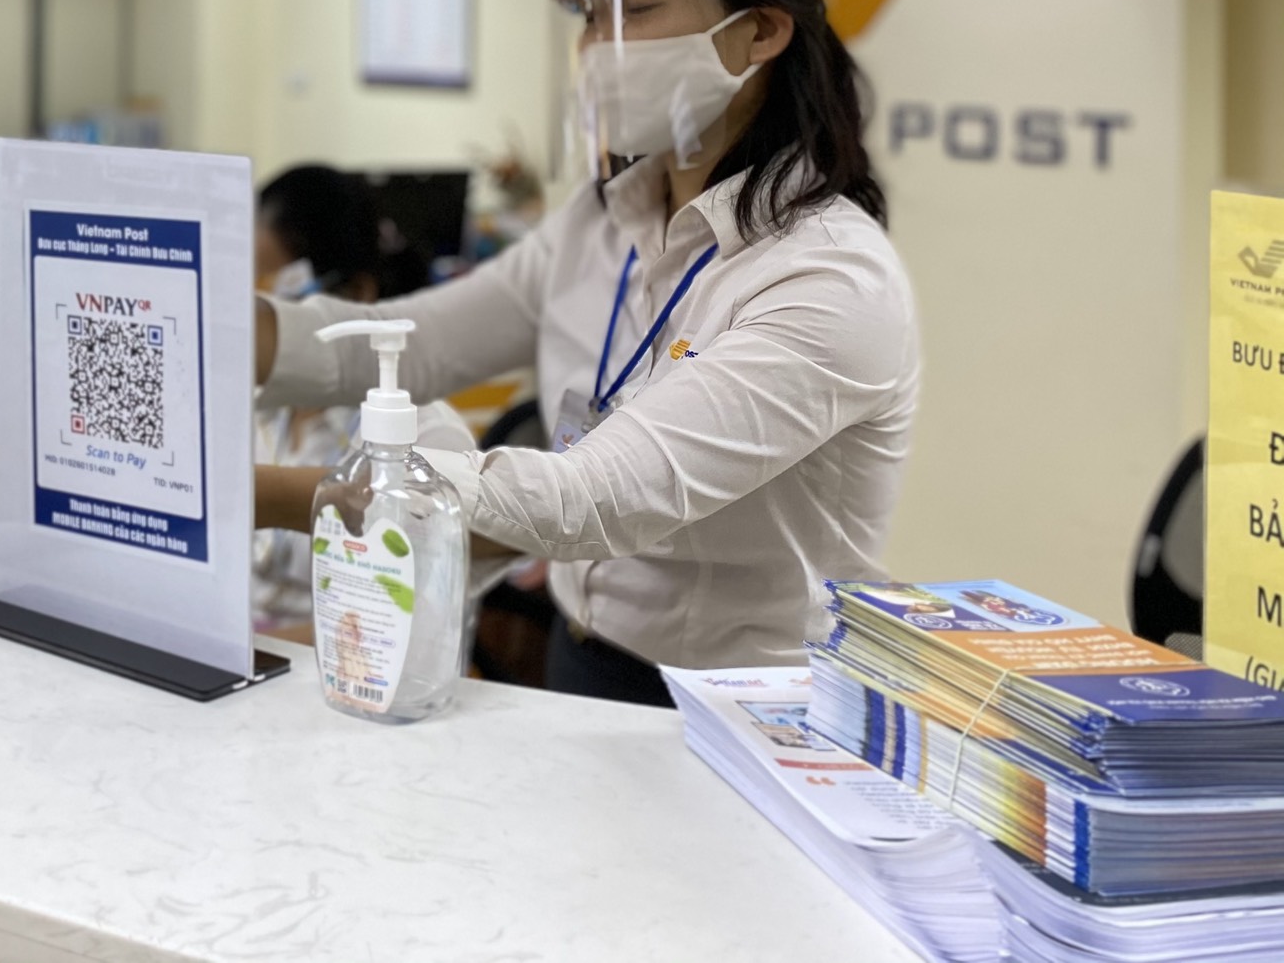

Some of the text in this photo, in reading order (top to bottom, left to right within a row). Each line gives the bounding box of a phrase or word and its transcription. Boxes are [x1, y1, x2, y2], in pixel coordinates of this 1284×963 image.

[889, 102, 1132, 172] POST
[76, 223, 149, 241] Vietnam Post
[1232, 340, 1273, 372] BƯU
[86, 444, 147, 470] Scan to Pay
